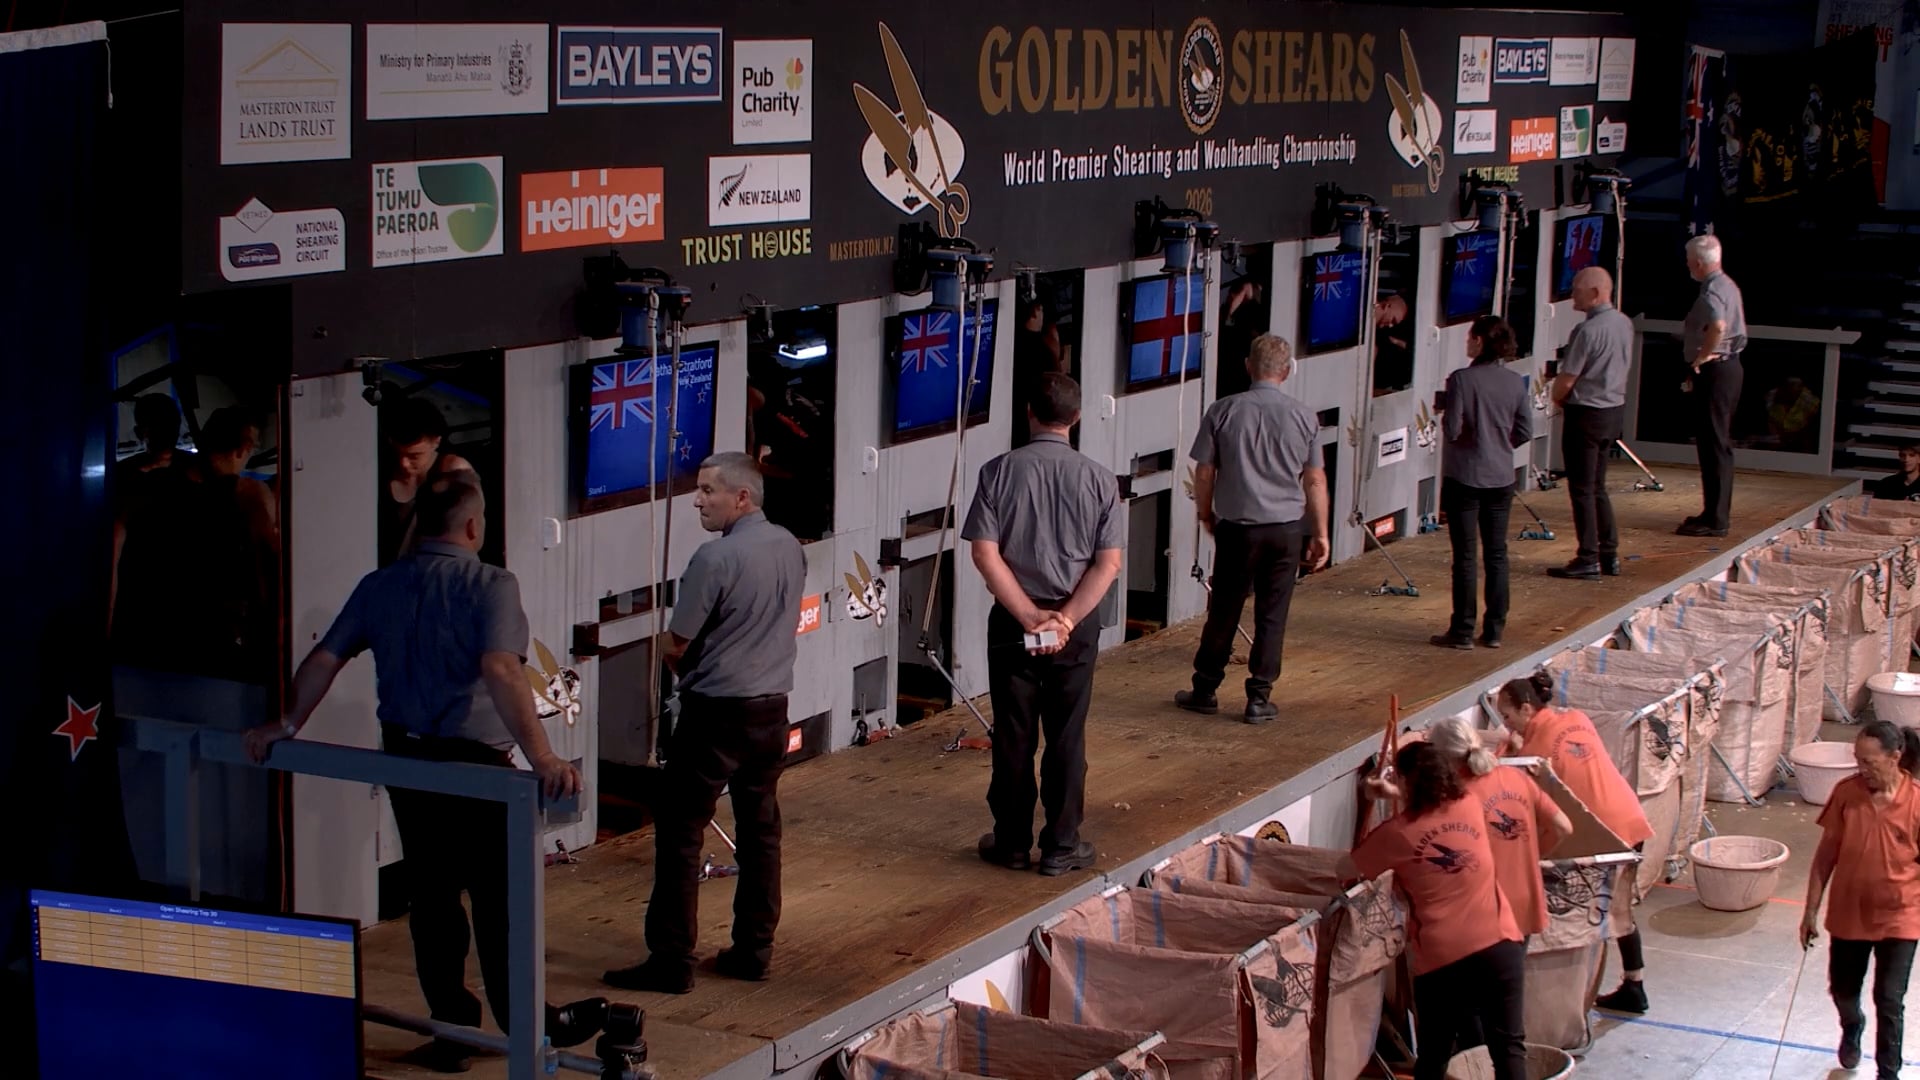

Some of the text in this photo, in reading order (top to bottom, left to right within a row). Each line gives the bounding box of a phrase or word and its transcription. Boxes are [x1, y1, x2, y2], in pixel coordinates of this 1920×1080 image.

[379, 53, 492, 71] Ministry for Primary Industries
[568, 44, 712, 87] BAYLEYS
[978, 26, 1173, 115] GOLDEN
[1229, 29, 1376, 105] SHEARS
[1498, 48, 1546, 73] BAYLEYS
[742, 67, 774, 88] Pub
[240, 101, 336, 115] MASTERTON TRUST
[742, 91, 800, 116] Charity
[240, 119, 336, 139] LANDS TRUST
[1511, 119, 1555, 157] Heiniger
[1004, 133, 1356, 186] World Premier Shearing and Woolhandling Championship
[376, 168, 395, 188] TE
[376, 189, 421, 211] TUMU
[528, 171, 660, 238] Heiniger
[739, 188, 801, 206] NEW ZEALAND
[1186, 187, 1213, 216] 2026
[296, 221, 338, 234] NATIONAL
[377, 211, 439, 235] PAEROA
[296, 234, 339, 248] SHEARING
[681, 227, 812, 266] TRUST HOUSE
[829, 234, 895, 262] MASTERTON.NZ
[296, 249, 329, 262] CIRCUIT
[160, 904, 175, 912] Open
